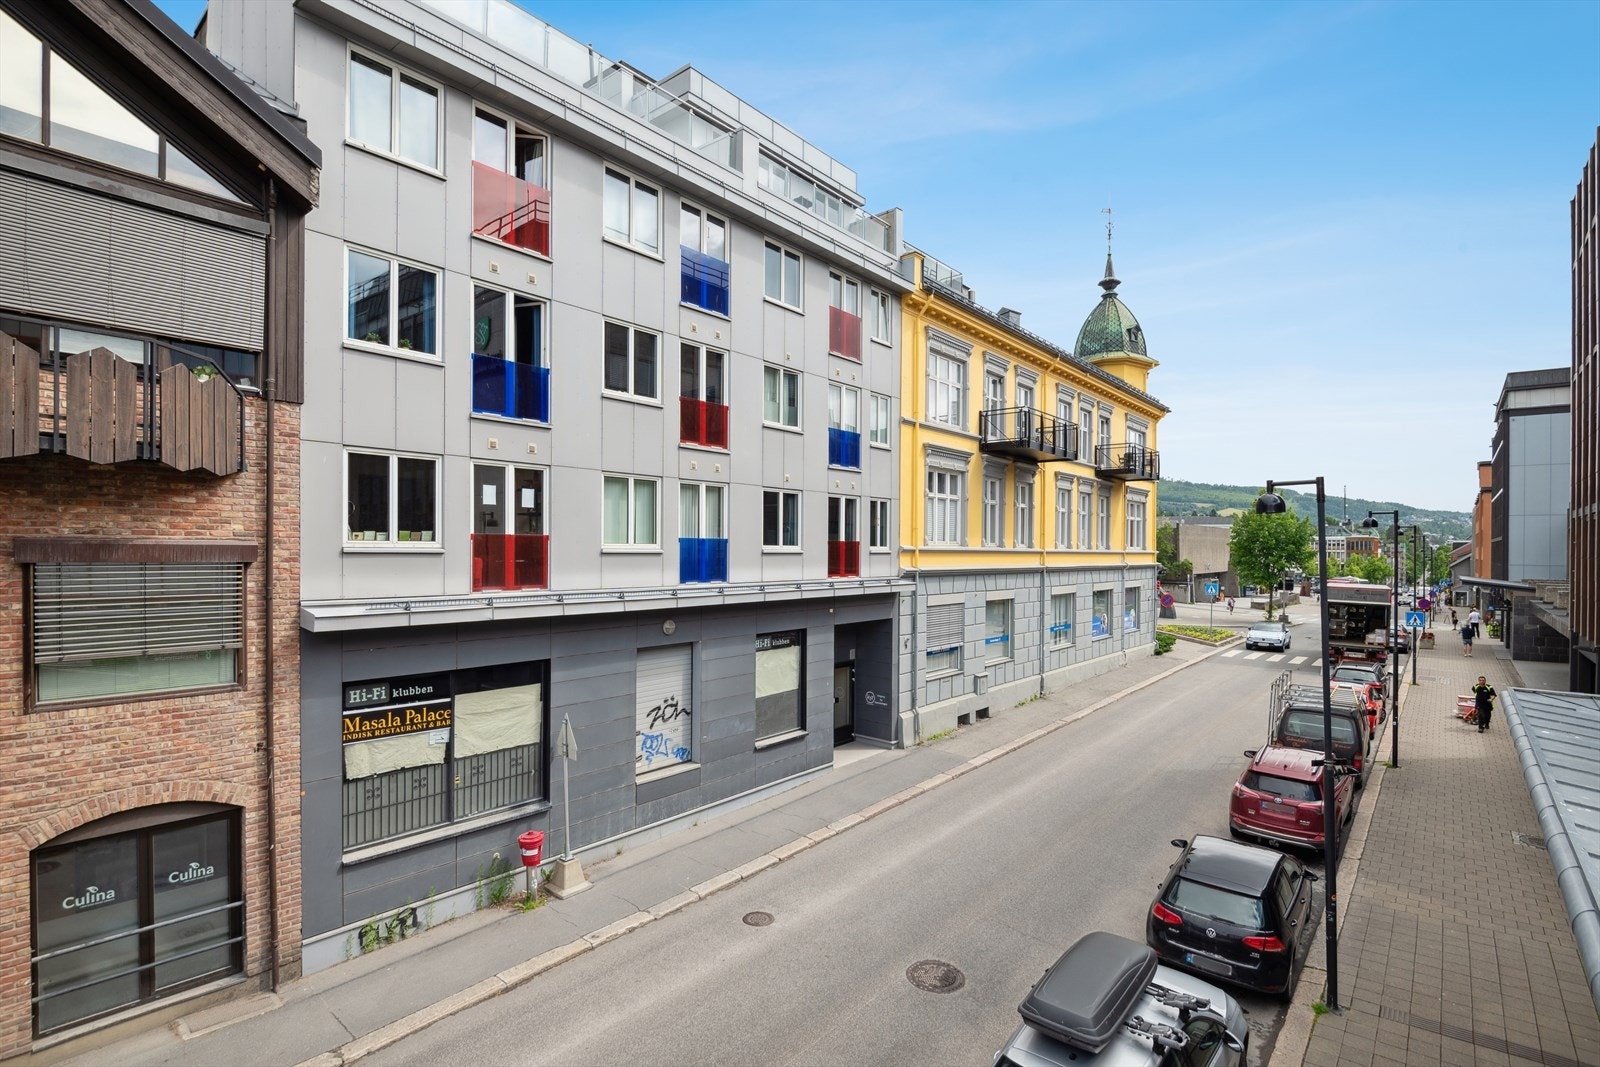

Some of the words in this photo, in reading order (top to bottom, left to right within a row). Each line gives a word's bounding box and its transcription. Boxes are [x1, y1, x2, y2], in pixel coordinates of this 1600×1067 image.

[349, 686, 387, 704] Hi-Fi
[392, 685, 434, 698] klubben
[343, 712, 401, 733] Masala
[405, 707, 451, 724] Palace
[343, 731, 373, 741] INDISK
[375, 723, 427, 736] RESTAURANT
[429, 720, 435, 728] &
[436, 719, 451, 727] BAR
[168, 863, 214, 884] Culina
[62, 888, 115, 910] Culina
